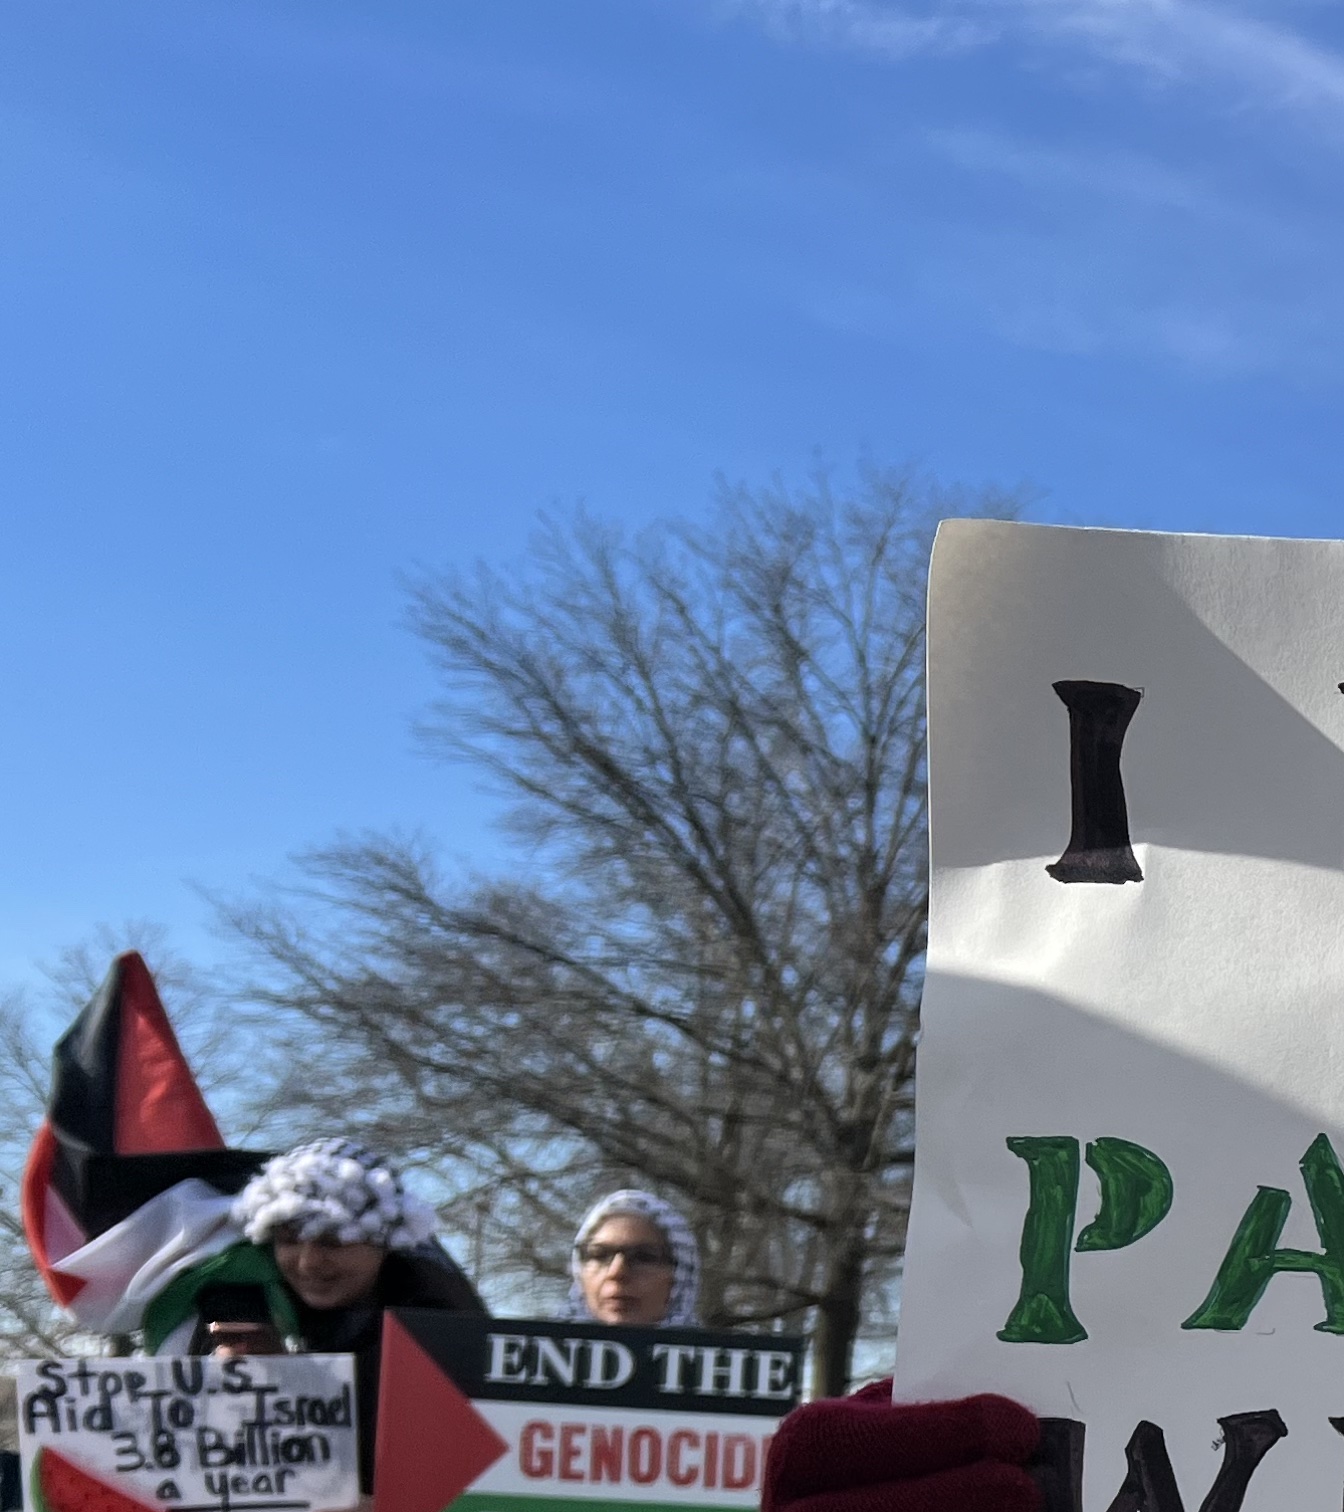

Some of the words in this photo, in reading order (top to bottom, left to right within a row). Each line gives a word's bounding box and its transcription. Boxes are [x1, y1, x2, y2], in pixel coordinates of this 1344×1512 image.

[1045, 680, 1145, 884] I
[36, 1359, 147, 1401] Stop
[484, 1333, 636, 1389] END
[651, 1343, 795, 1400] THE
[24, 1389, 114, 1433] Aid
[135, 1389, 195, 1430] To
[243, 1383, 352, 1427] Israel
[199, 1426, 331, 1468] Billion
[518, 1420, 772, 1490] GENOCID
[156, 1478, 182, 1500] a
